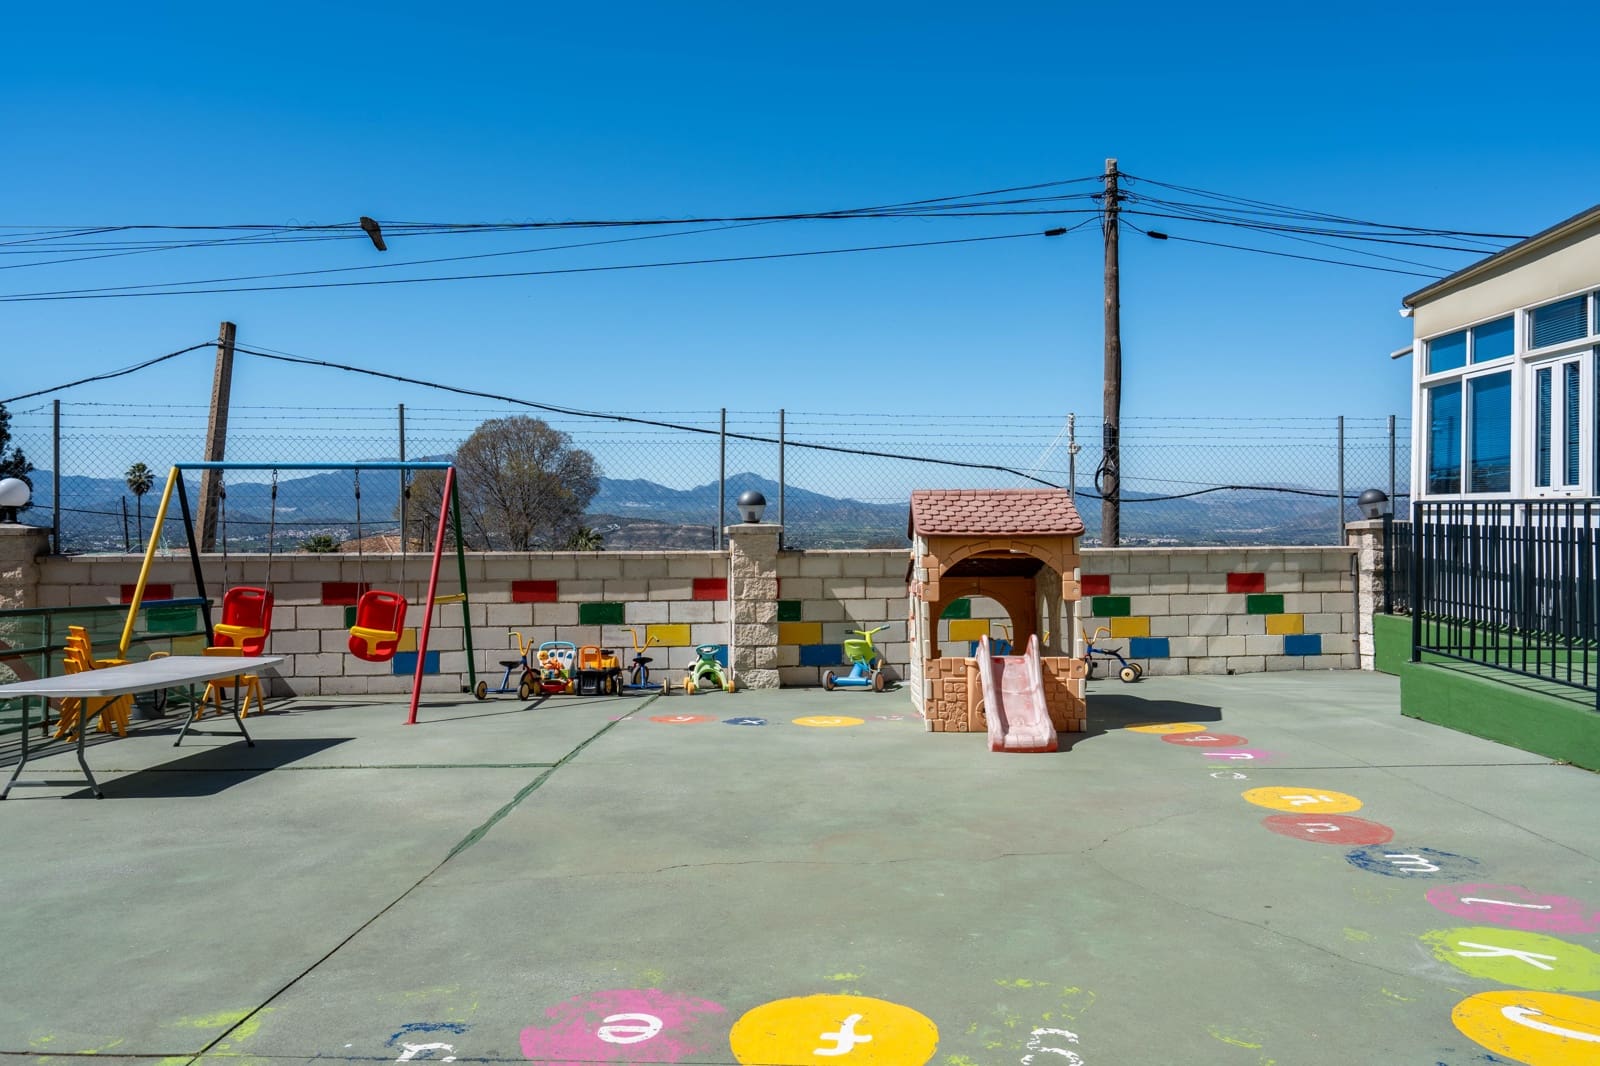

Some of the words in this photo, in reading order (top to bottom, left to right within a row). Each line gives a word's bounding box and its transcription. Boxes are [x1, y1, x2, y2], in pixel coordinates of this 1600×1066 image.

[1384, 853, 1441, 873] m
[597, 1012, 664, 1045] e
[813, 1013, 873, 1056] f
